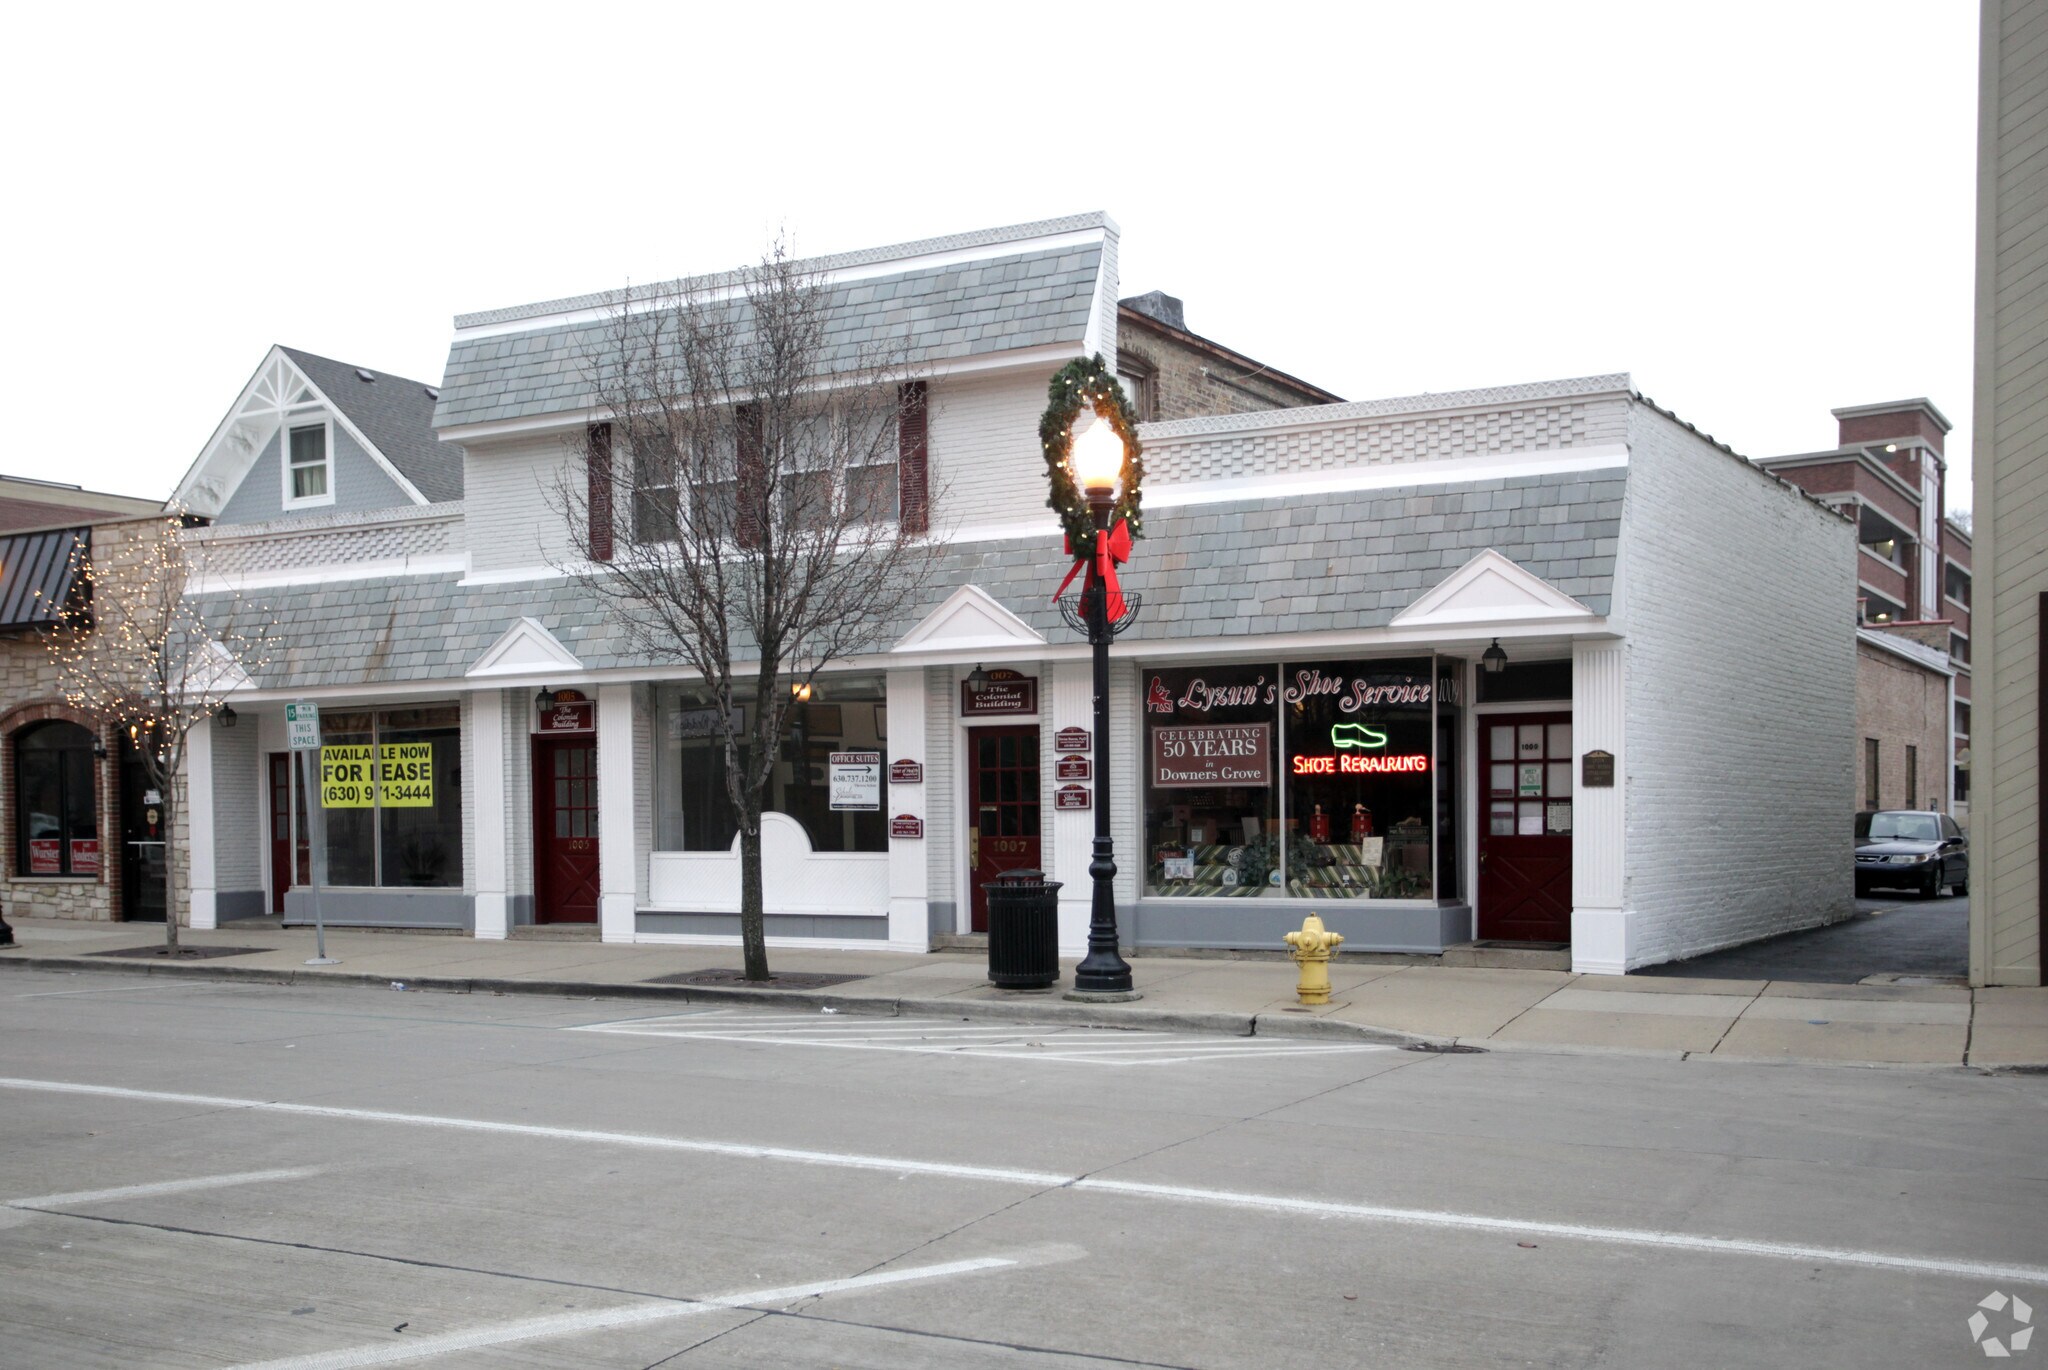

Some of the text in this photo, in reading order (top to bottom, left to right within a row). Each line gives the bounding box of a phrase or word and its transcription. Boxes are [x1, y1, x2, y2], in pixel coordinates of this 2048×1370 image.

[987, 685, 1009, 693] The
[1178, 670, 1432, 712] Lyzun's Shoe Service
[975, 692, 1023, 701] Colonial
[975, 700, 1022, 709] Building
[288, 708, 296, 719] 15
[295, 724, 312, 733] THIS
[1159, 728, 1261, 741] CELEBRATING
[293, 736, 316, 746] SPACE
[323, 746, 430, 761] AVAILALE NOW
[1163, 738, 1257, 758] 50 YEARS
[832, 754, 879, 763] OFFICE SUITES
[1205, 760, 1214, 768] in
[1293, 756, 1336, 774] SHOE
[323, 764, 363, 782] FOR
[1160, 766, 1261, 780] Downers Grove
[324, 785, 431, 805] (630) 91-3444
[993, 840, 1027, 852] 1007
